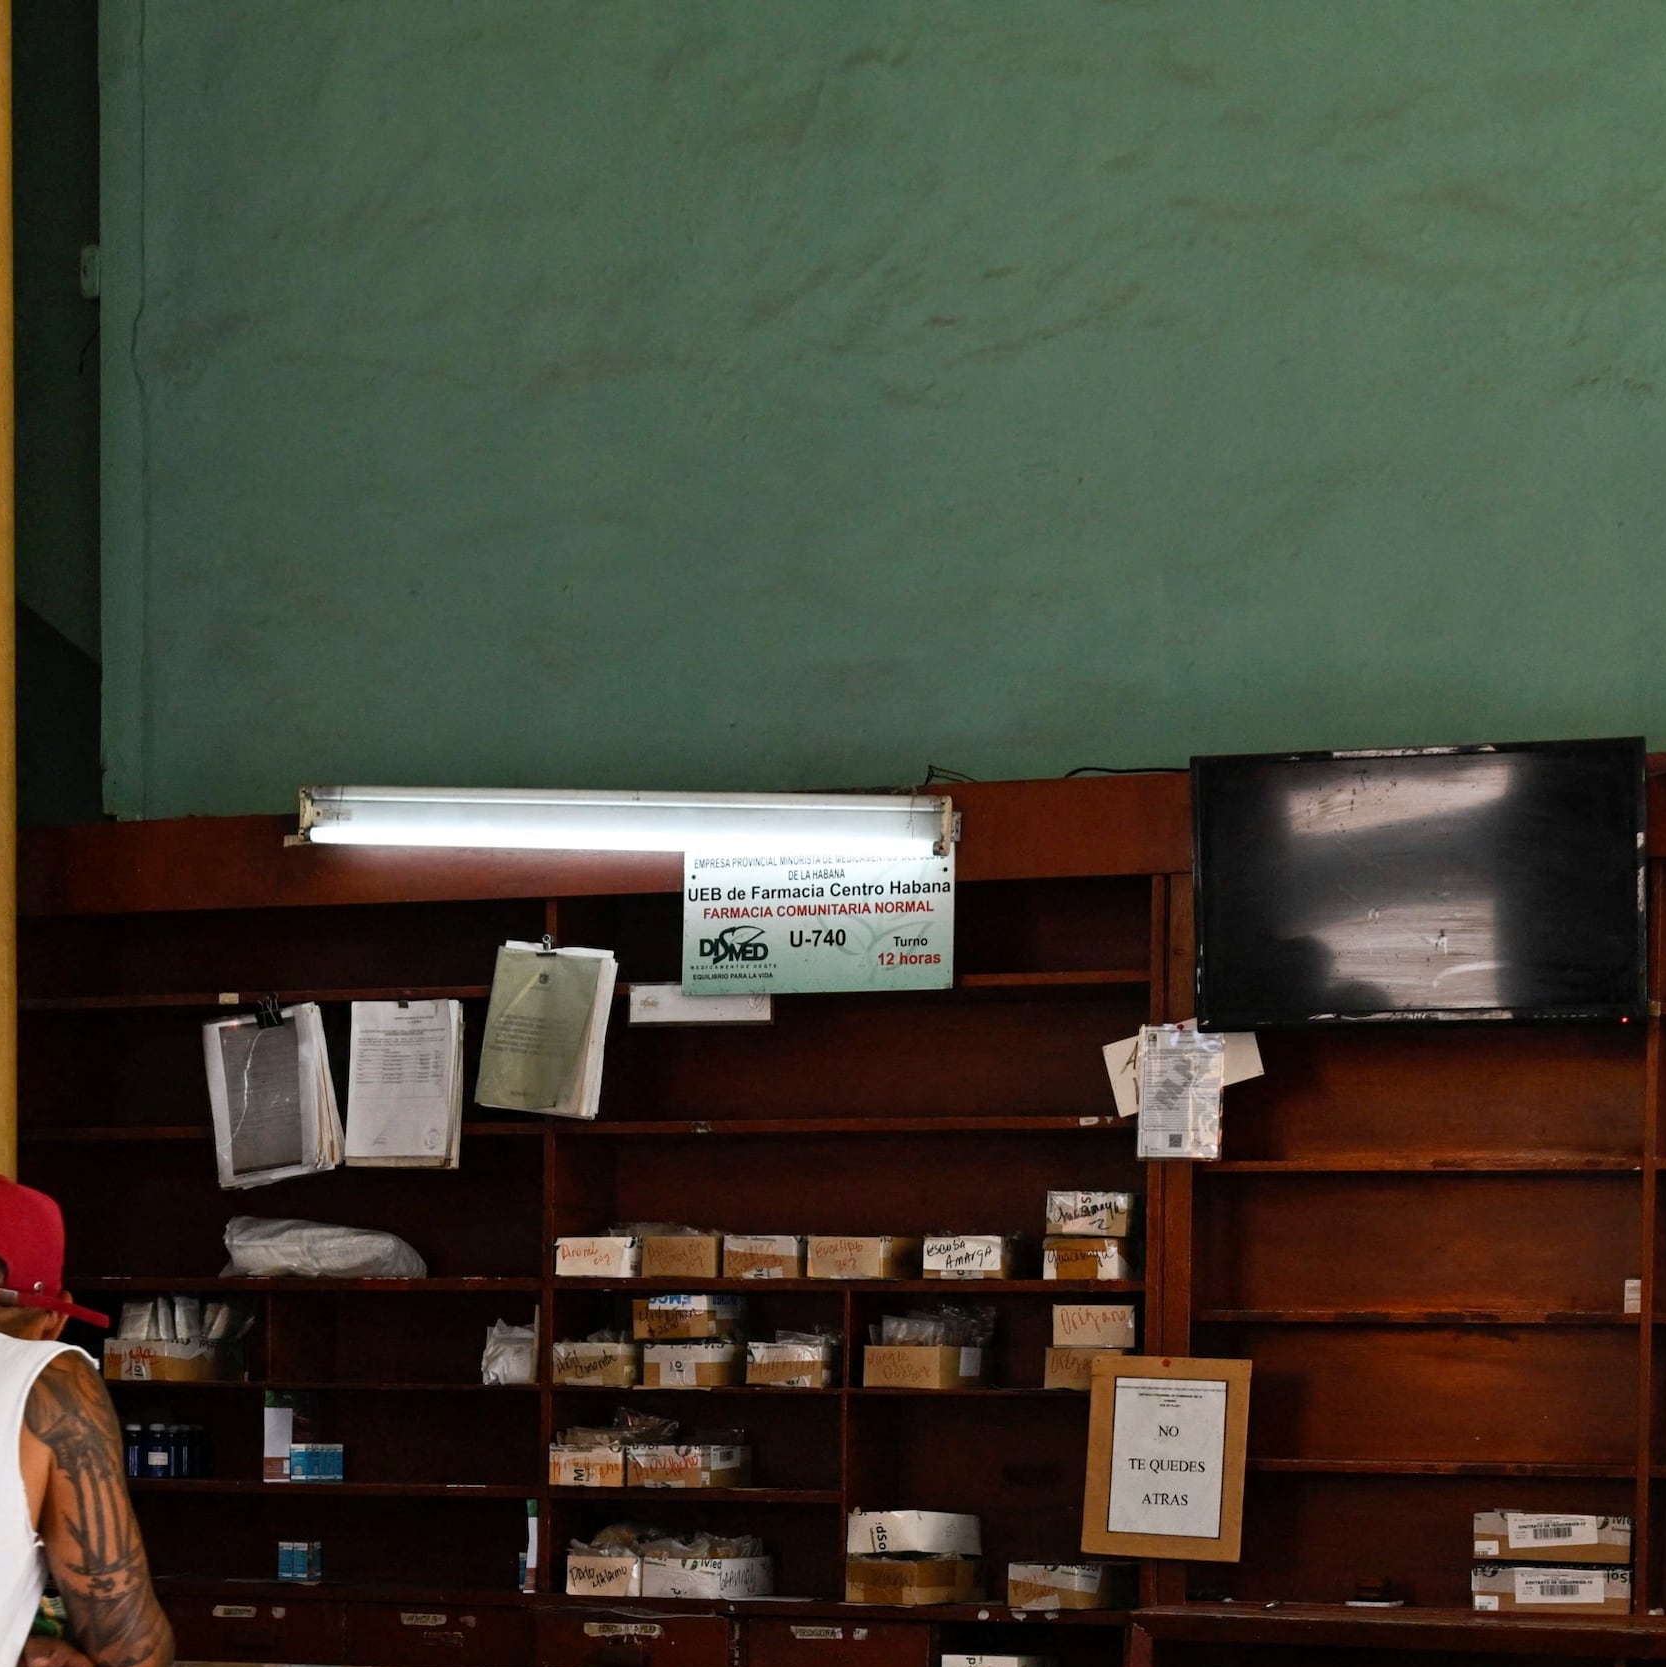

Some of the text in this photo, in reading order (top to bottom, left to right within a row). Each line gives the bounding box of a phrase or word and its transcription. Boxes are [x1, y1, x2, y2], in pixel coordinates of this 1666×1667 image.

[694, 858, 731, 869] EMPRESA
[732, 856, 777, 868] PROVINCIAL
[788, 868, 845, 880] DE LA HABANA
[688, 880, 951, 902] UEB de Farmacia Centro Habana
[703, 900, 934, 919] FARMACIA COMUNITARIA NORMAL
[790, 929, 846, 947] U-740
[893, 936, 928, 947] Turno
[878, 952, 942, 966] 12 horas
[1158, 1425, 1179, 1437] NO
[1128, 1458, 1205, 1473] TE QUEDES
[1141, 1493, 1188, 1506] ATRAS
